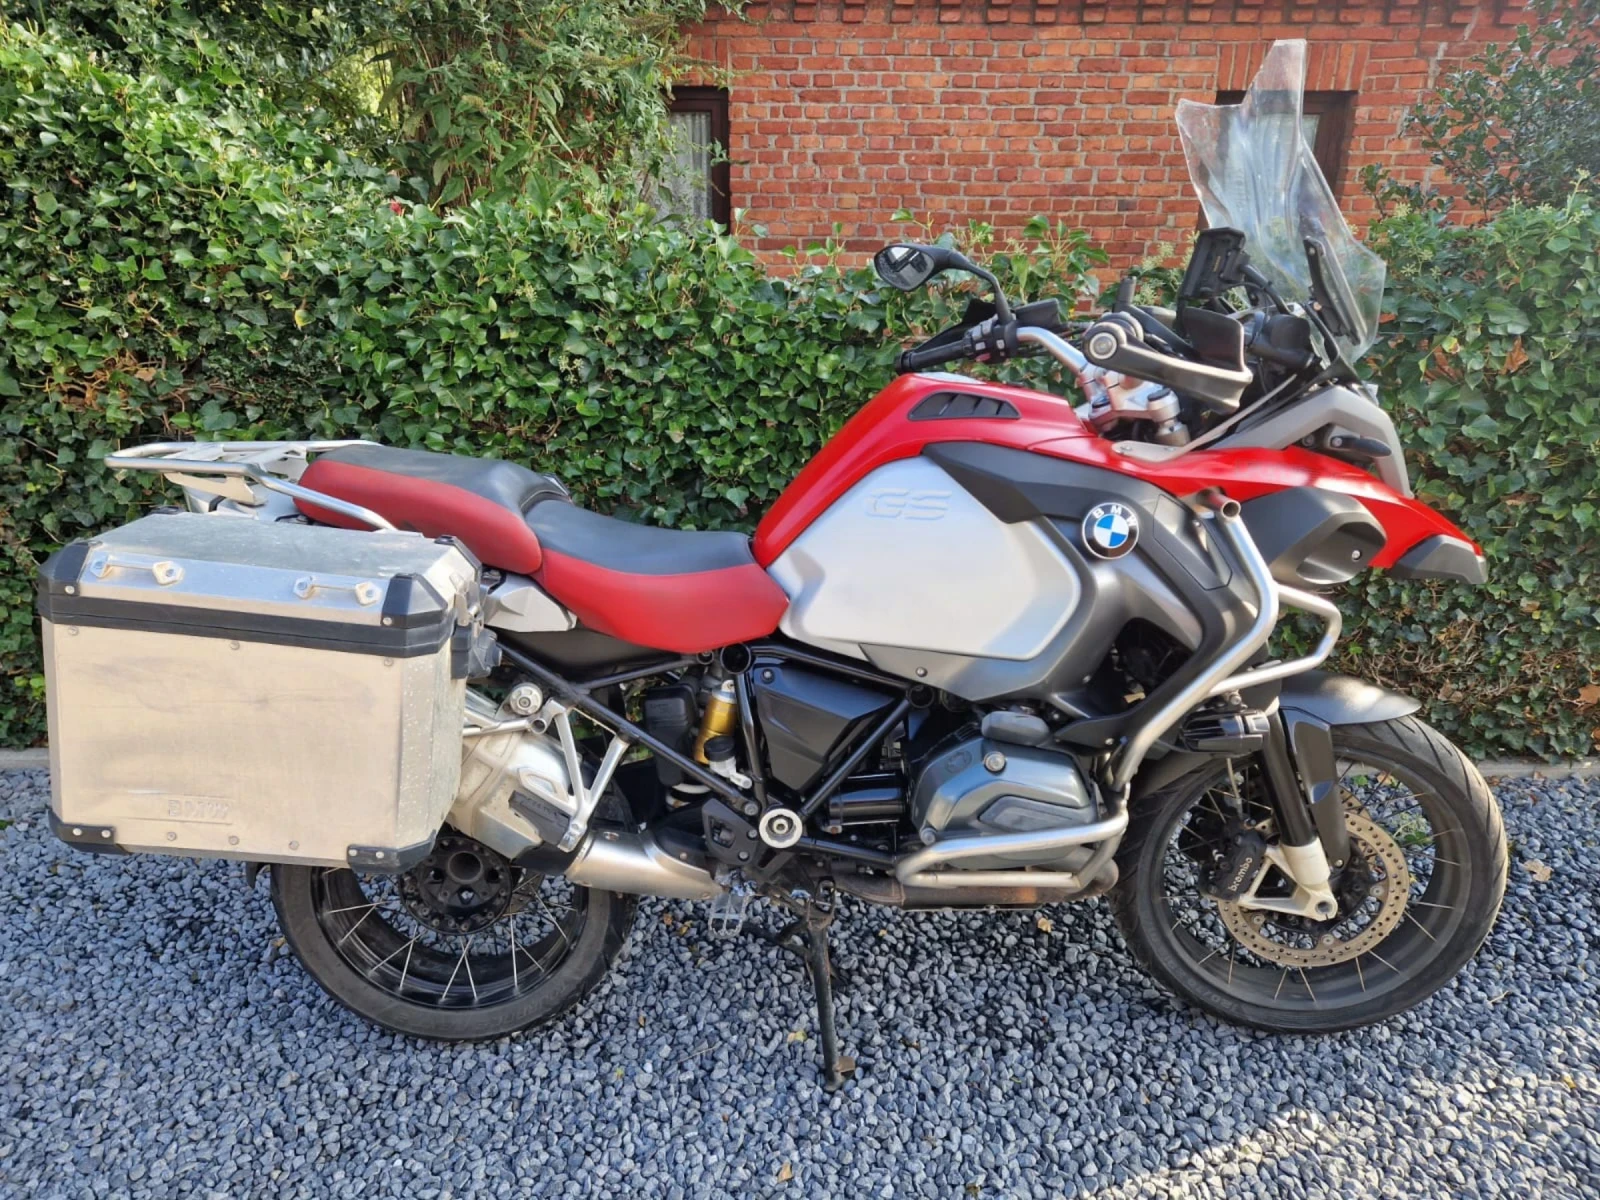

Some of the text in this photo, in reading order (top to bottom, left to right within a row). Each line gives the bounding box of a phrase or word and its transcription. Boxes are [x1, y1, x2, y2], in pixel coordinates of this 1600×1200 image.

[865, 488, 952, 520] GS
[1092, 504, 1137, 527] BMW
[1228, 857, 1253, 891] brembo
